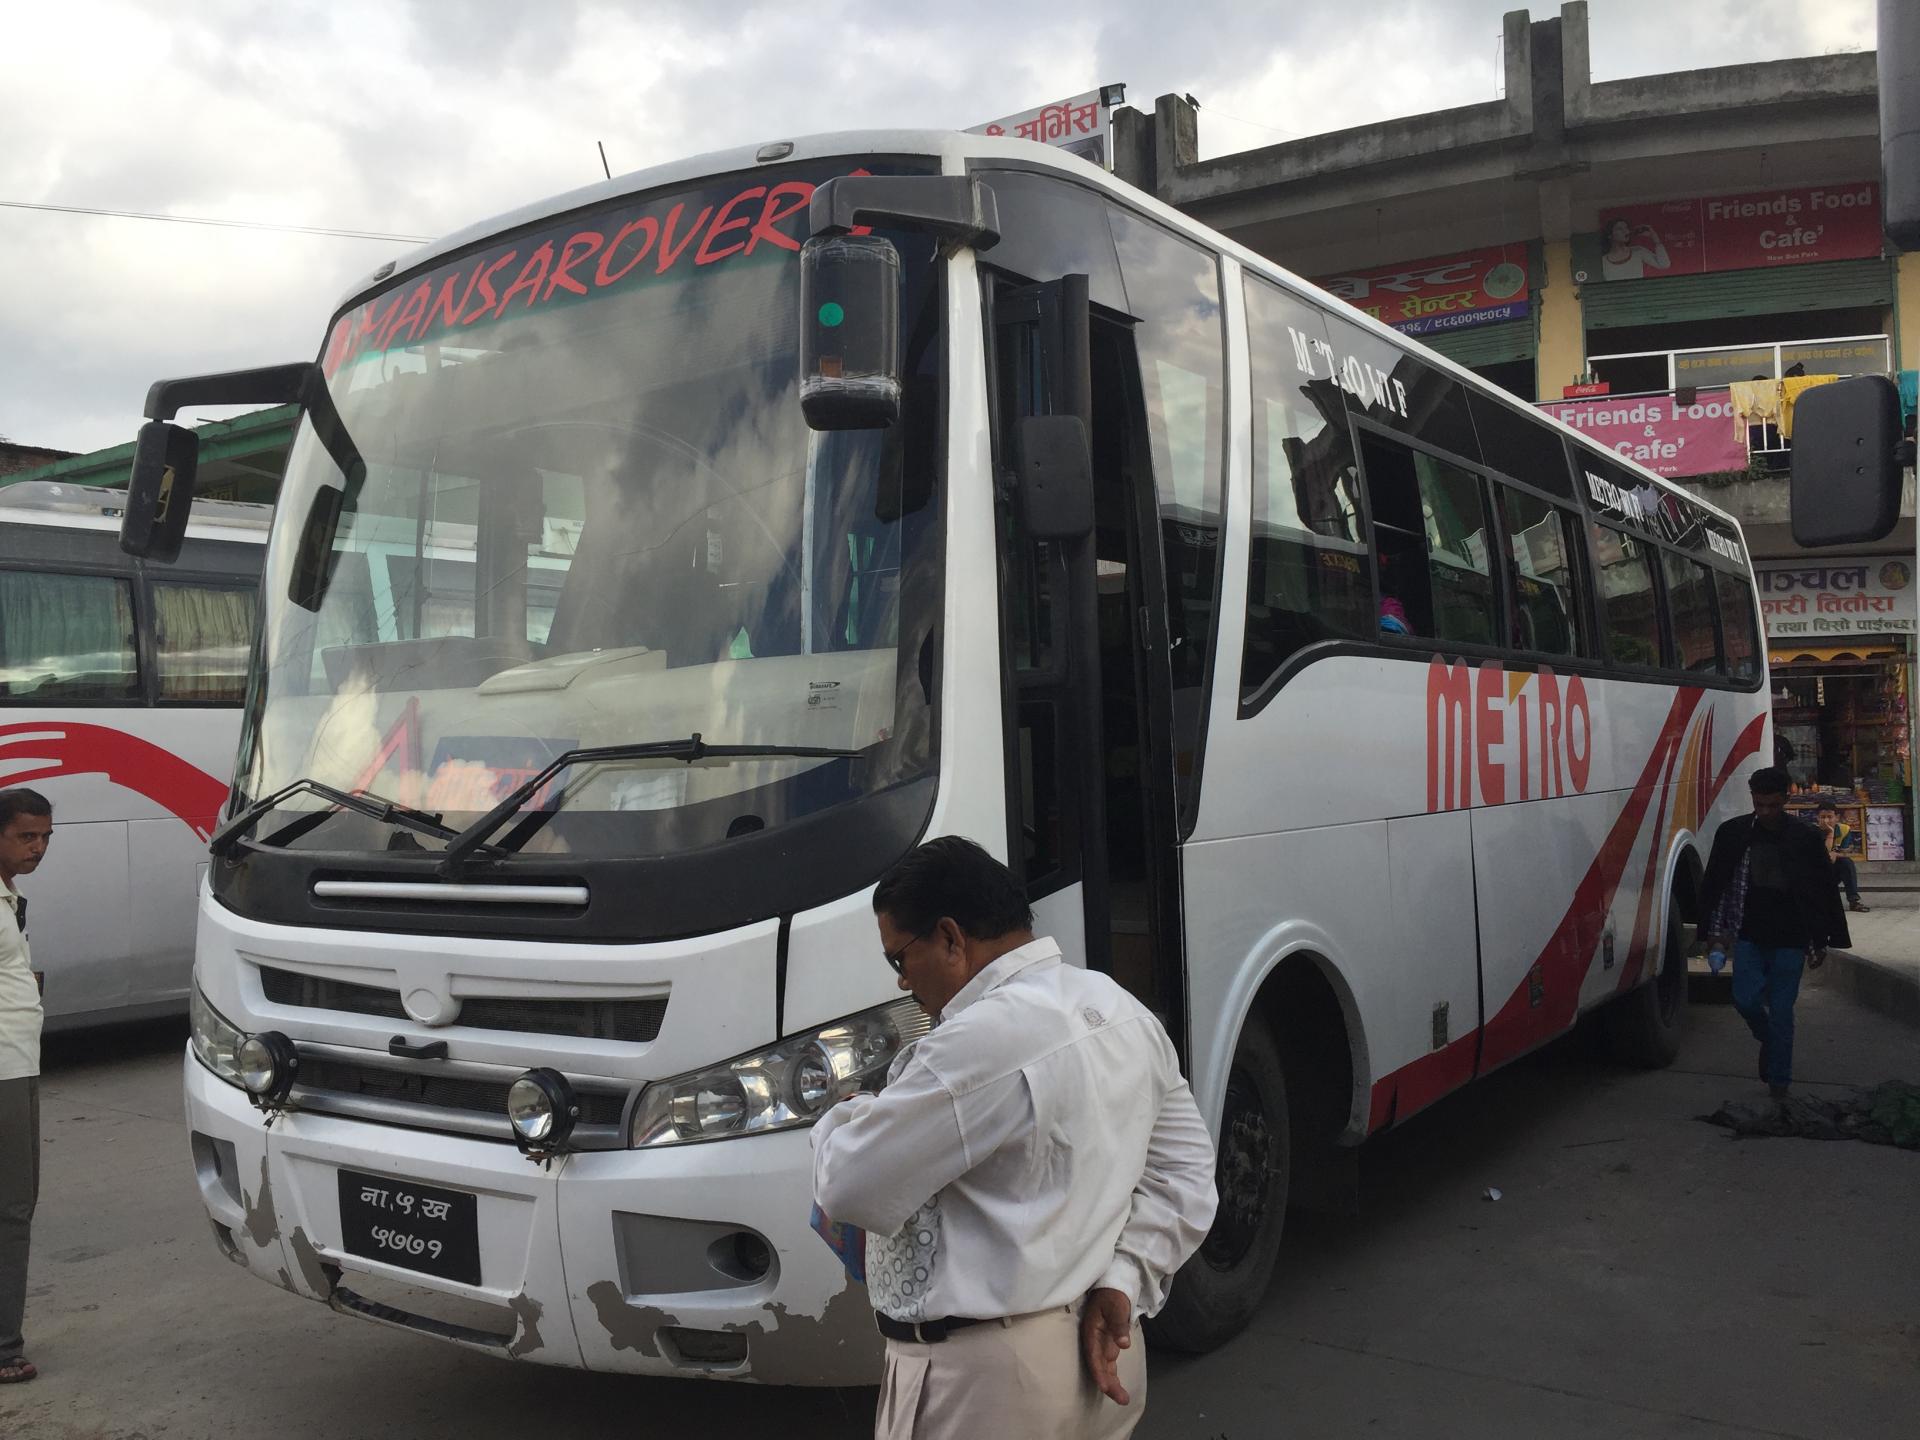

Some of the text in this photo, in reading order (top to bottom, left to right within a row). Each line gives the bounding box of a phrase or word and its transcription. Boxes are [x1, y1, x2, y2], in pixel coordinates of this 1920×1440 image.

[1708, 198, 1801, 221] Friends
[1810, 187, 1872, 211] Food
[1785, 213, 1796, 226] &
[1399, 289, 1478, 319] सेन्टर
[1560, 403, 1662, 428] Friends
[1643, 425, 1656, 437] &
[1776, 621, 1808, 633] तथा
[1426, 652, 1592, 813] METRO
[371, 1225, 443, 1260] ५७७१
